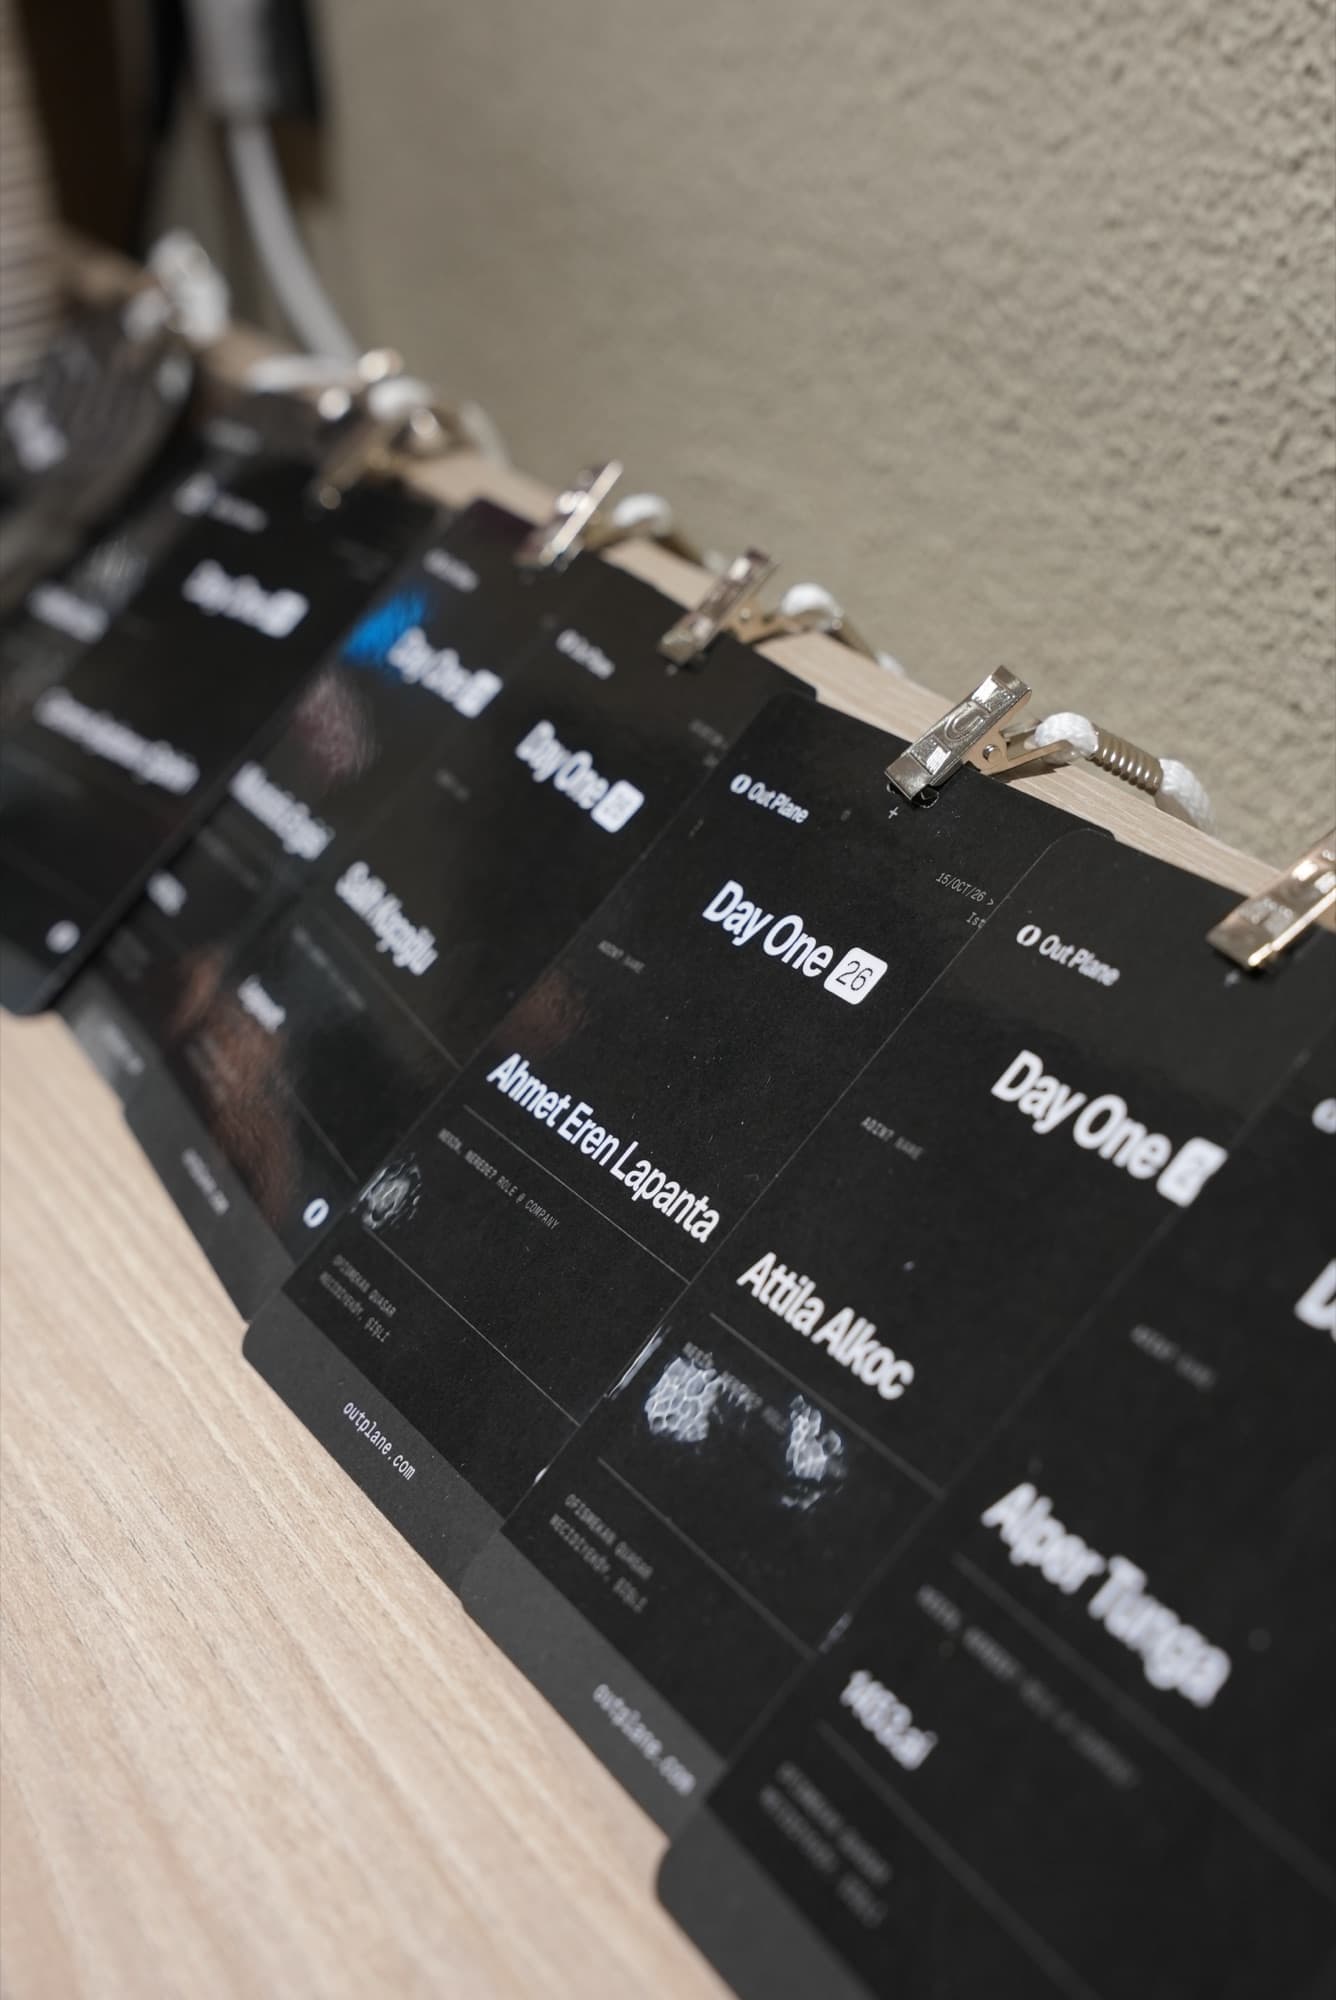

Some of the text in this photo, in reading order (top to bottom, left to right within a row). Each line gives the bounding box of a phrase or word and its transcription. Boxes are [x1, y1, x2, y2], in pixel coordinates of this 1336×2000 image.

[747, 781, 809, 823] Out Plane
[702, 880, 774, 947] Day
[763, 914, 834, 978] One
[1039, 934, 1120, 987] Out Plane
[486, 1053, 720, 1244] Ahmet Eren Lapanta
[990, 1049, 1087, 1135] Day
[1073, 1094, 1172, 1180] One
[496, 1175, 518, 1197] ROLE
[524, 1199, 560, 1230] COMPANY
[736, 1251, 825, 1337] Attila
[810, 1306, 915, 1400] Alkoc
[343, 1402, 416, 1480] outplane.com
[981, 1483, 1107, 1594] Alper
[1087, 1554, 1231, 1709] Tunga
